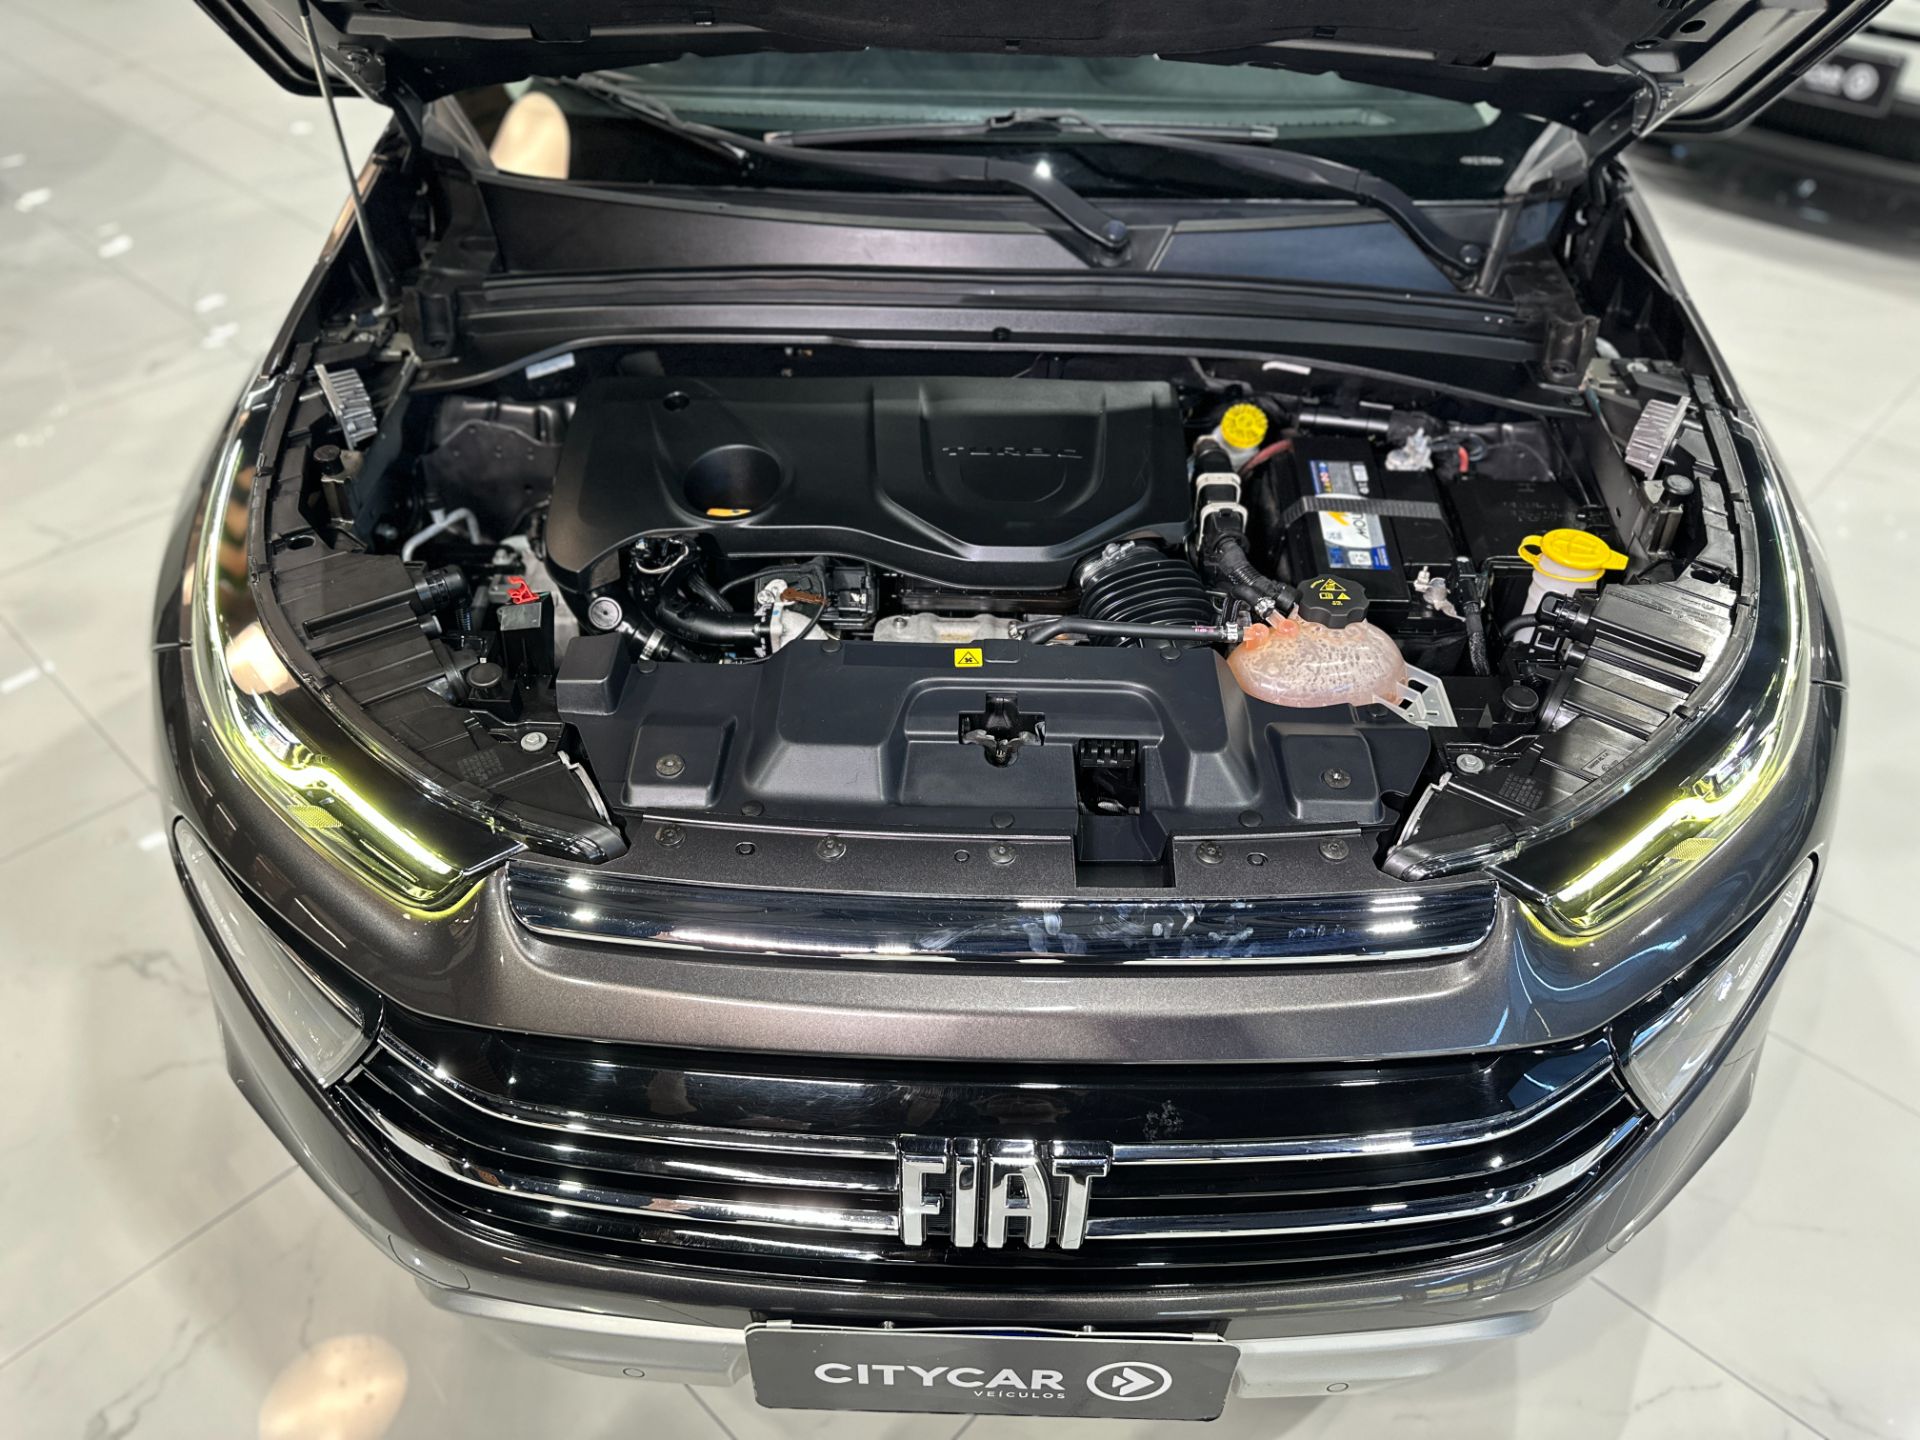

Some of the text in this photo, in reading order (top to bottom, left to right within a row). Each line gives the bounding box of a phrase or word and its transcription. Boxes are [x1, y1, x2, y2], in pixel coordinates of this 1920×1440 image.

[899, 1136, 1112, 1250] FIAT
[814, 1362, 1066, 1390] CITYCAR
[973, 1390, 1066, 1399] VEÍCULOS
